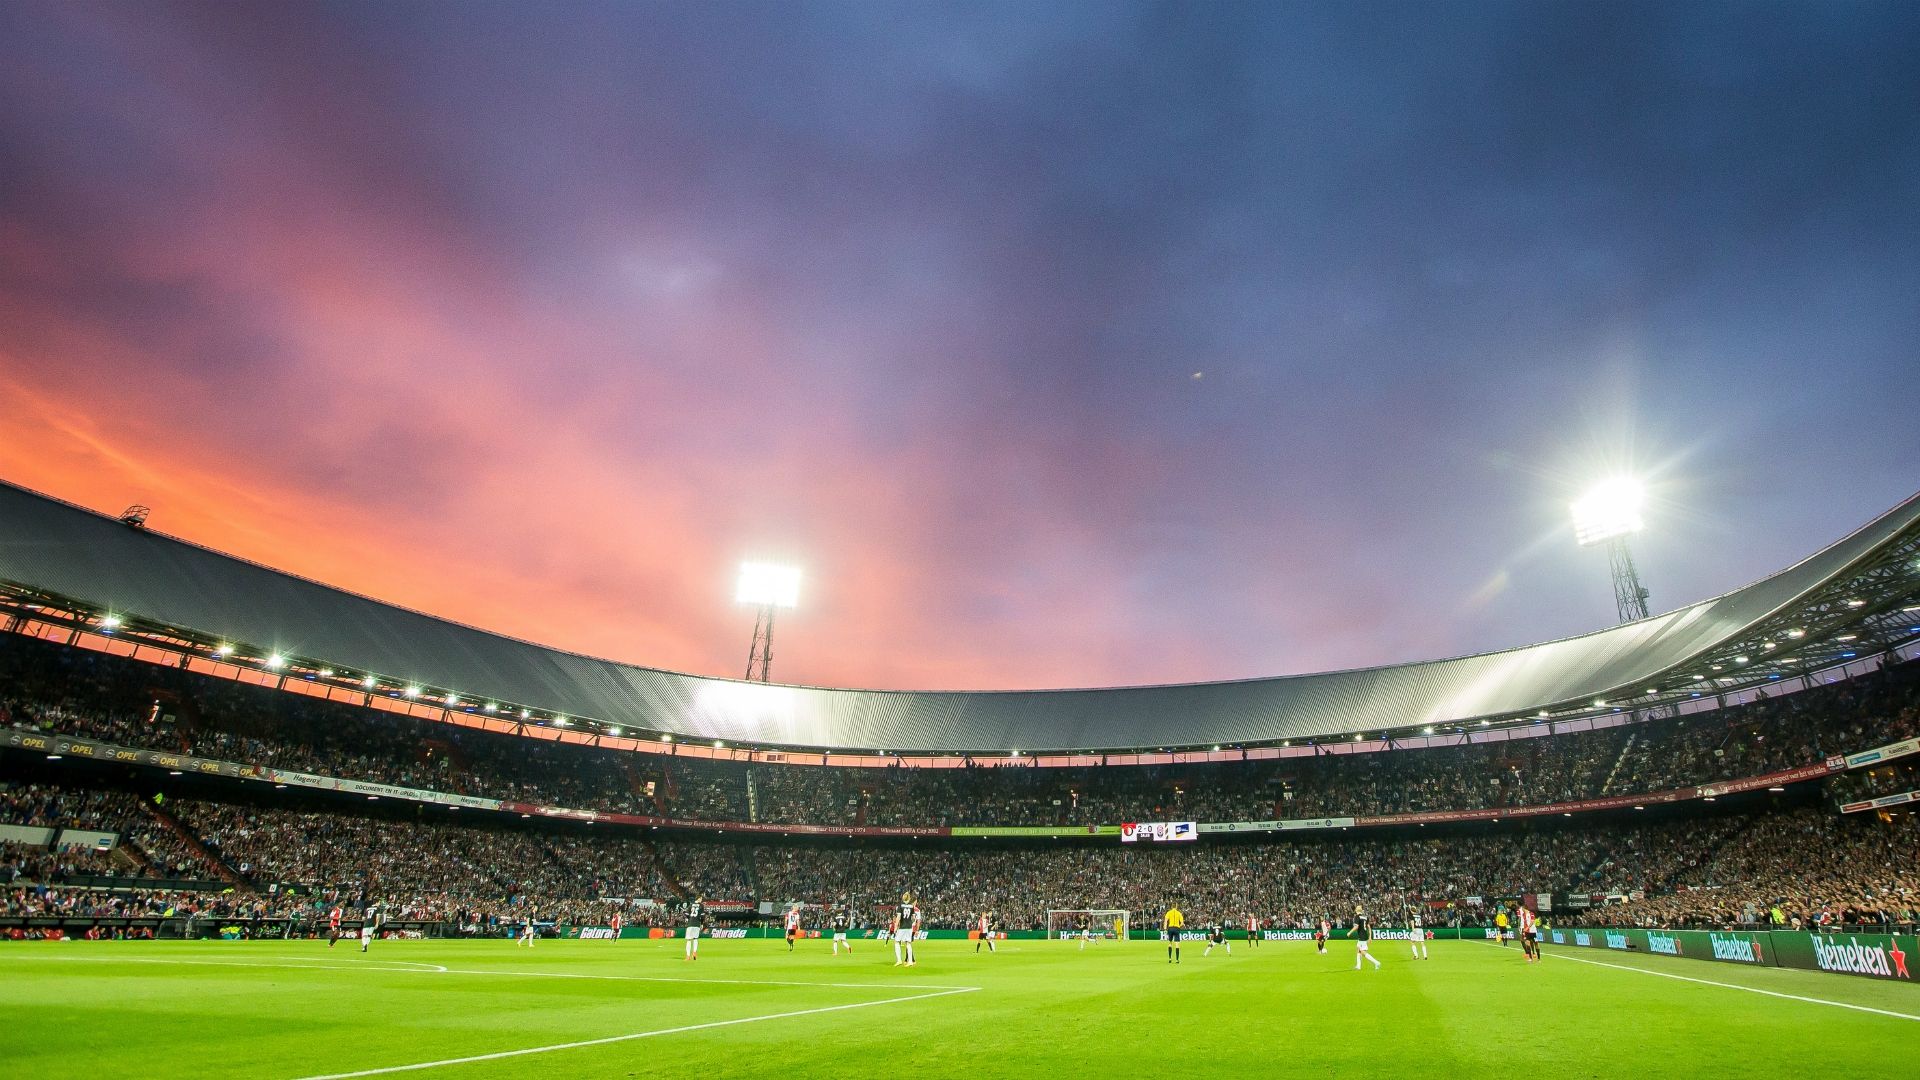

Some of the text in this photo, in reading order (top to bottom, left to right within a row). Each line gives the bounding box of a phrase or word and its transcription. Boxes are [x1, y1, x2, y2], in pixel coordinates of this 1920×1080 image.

[22, 737, 45, 749] OPEL
[71, 744, 94, 756] OPEL
[116, 751, 138, 761] OPEL
[160, 757, 180, 767] OPEL
[201, 762, 220, 772] OPEL
[690, 906, 699, 917] 25
[903, 908, 911, 919] 99
[580, 926, 622, 939] Gatora
[711, 928, 747, 938] Gatorade
[1264, 930, 1312, 940] Heineken
[1710, 932, 1755, 962] Heineken
[1810, 932, 1892, 976] Heineken
